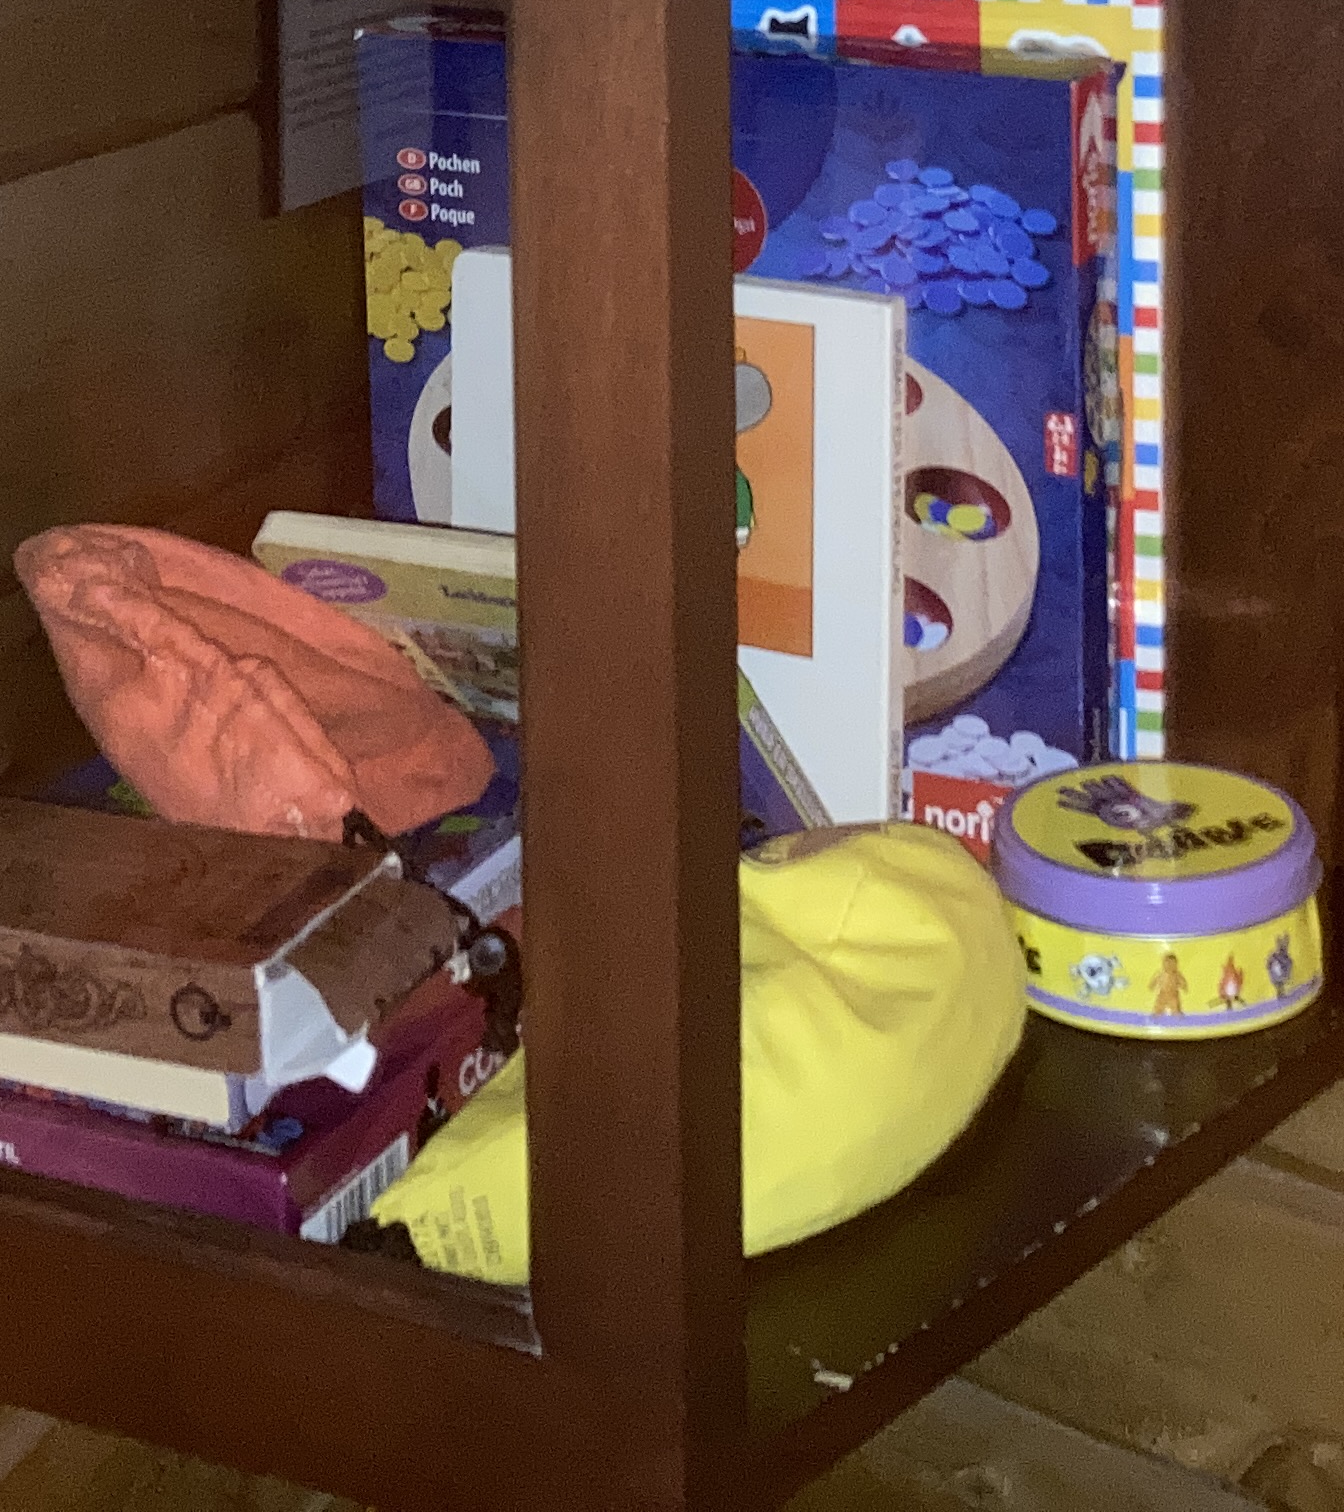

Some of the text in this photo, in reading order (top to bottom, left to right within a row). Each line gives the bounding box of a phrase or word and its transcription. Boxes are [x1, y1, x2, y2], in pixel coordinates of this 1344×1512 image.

[429, 151, 481, 174] Pochen
[430, 177, 464, 198] Poch
[430, 203, 476, 228] Poque
